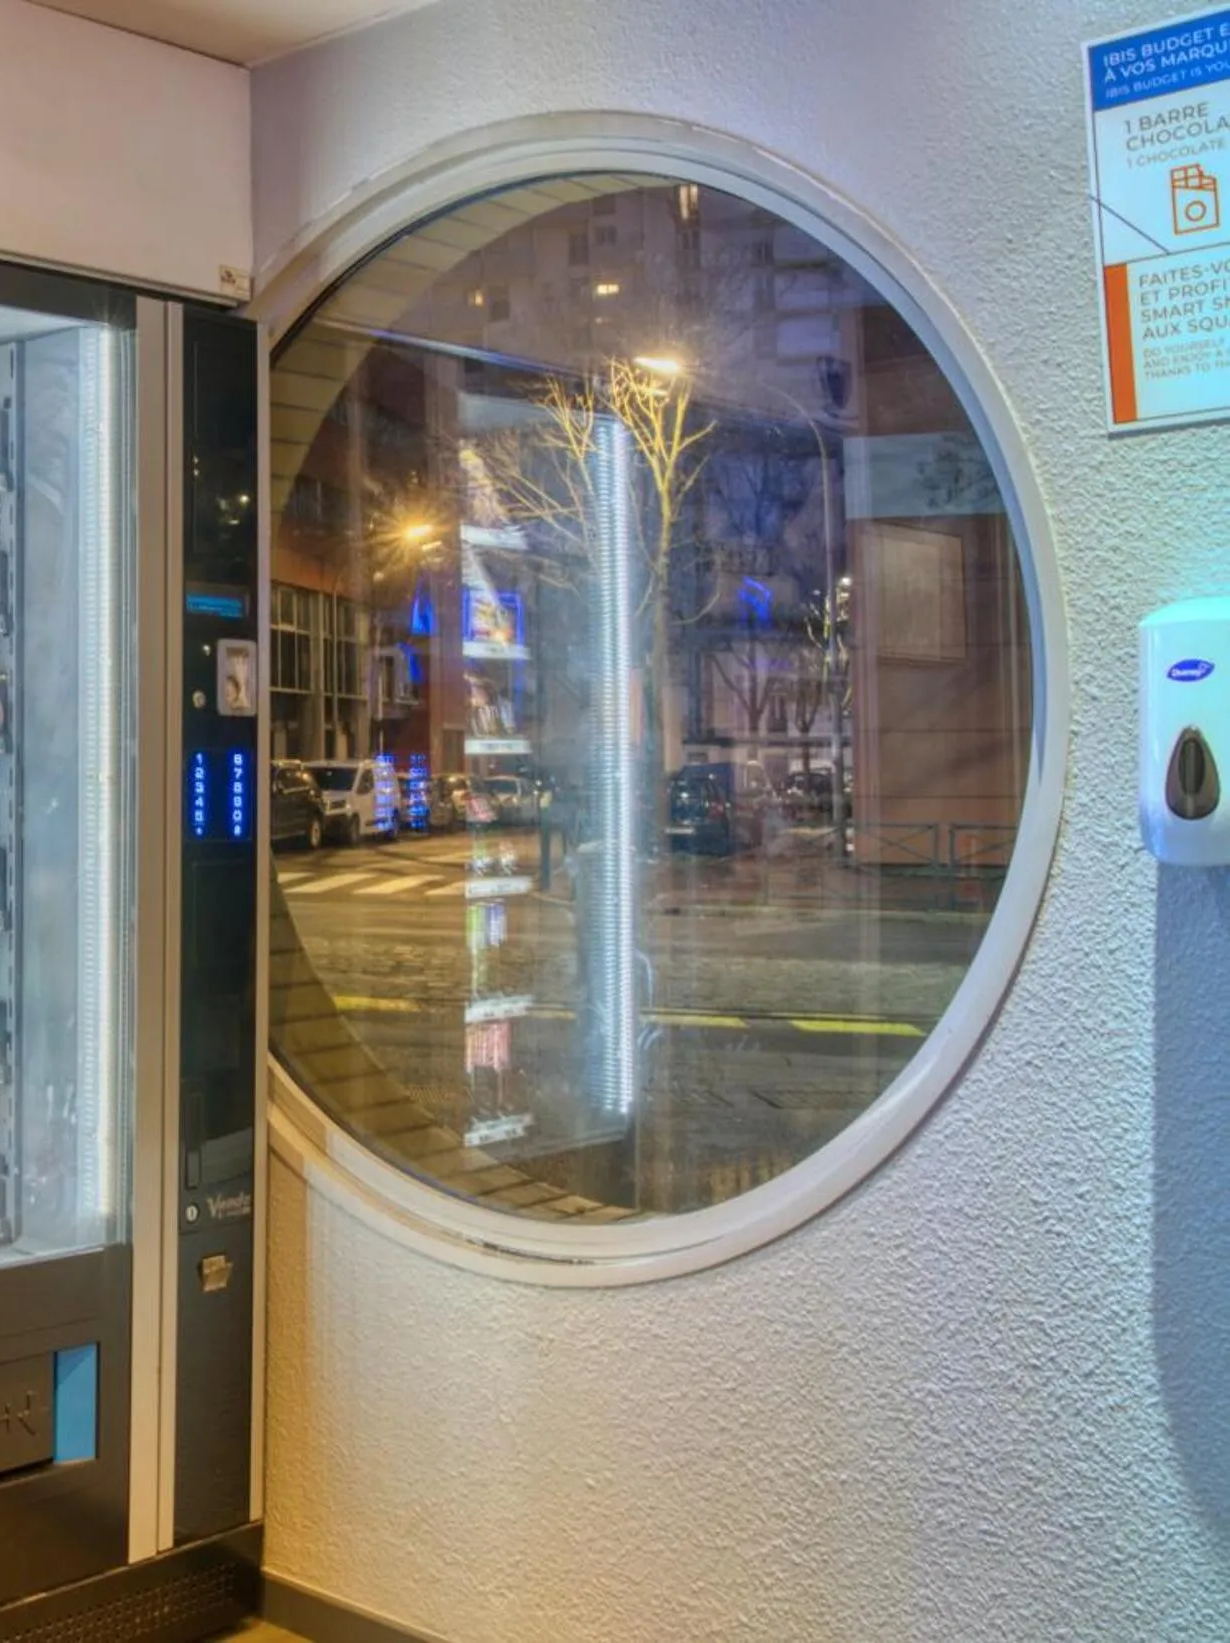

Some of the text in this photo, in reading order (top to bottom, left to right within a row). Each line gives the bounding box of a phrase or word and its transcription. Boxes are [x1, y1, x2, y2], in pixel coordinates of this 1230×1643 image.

[1103, 48, 1137, 67] IBIS
[1141, 26, 1214, 58] BUDGET
[1120, 58, 1156, 79] VOS
[1161, 39, 1230, 69] MARQU
[1106, 83, 1130, 99] IBIS
[1134, 69, 1187, 93] BUDGET
[1124, 102, 1210, 134] 1 BARRE
[1136, 138, 1225, 167] CHOCOLATE
[1140, 290, 1159, 306] ET
[1141, 299, 1205, 323] SMART
[1142, 315, 1230, 341] AUX SQU
